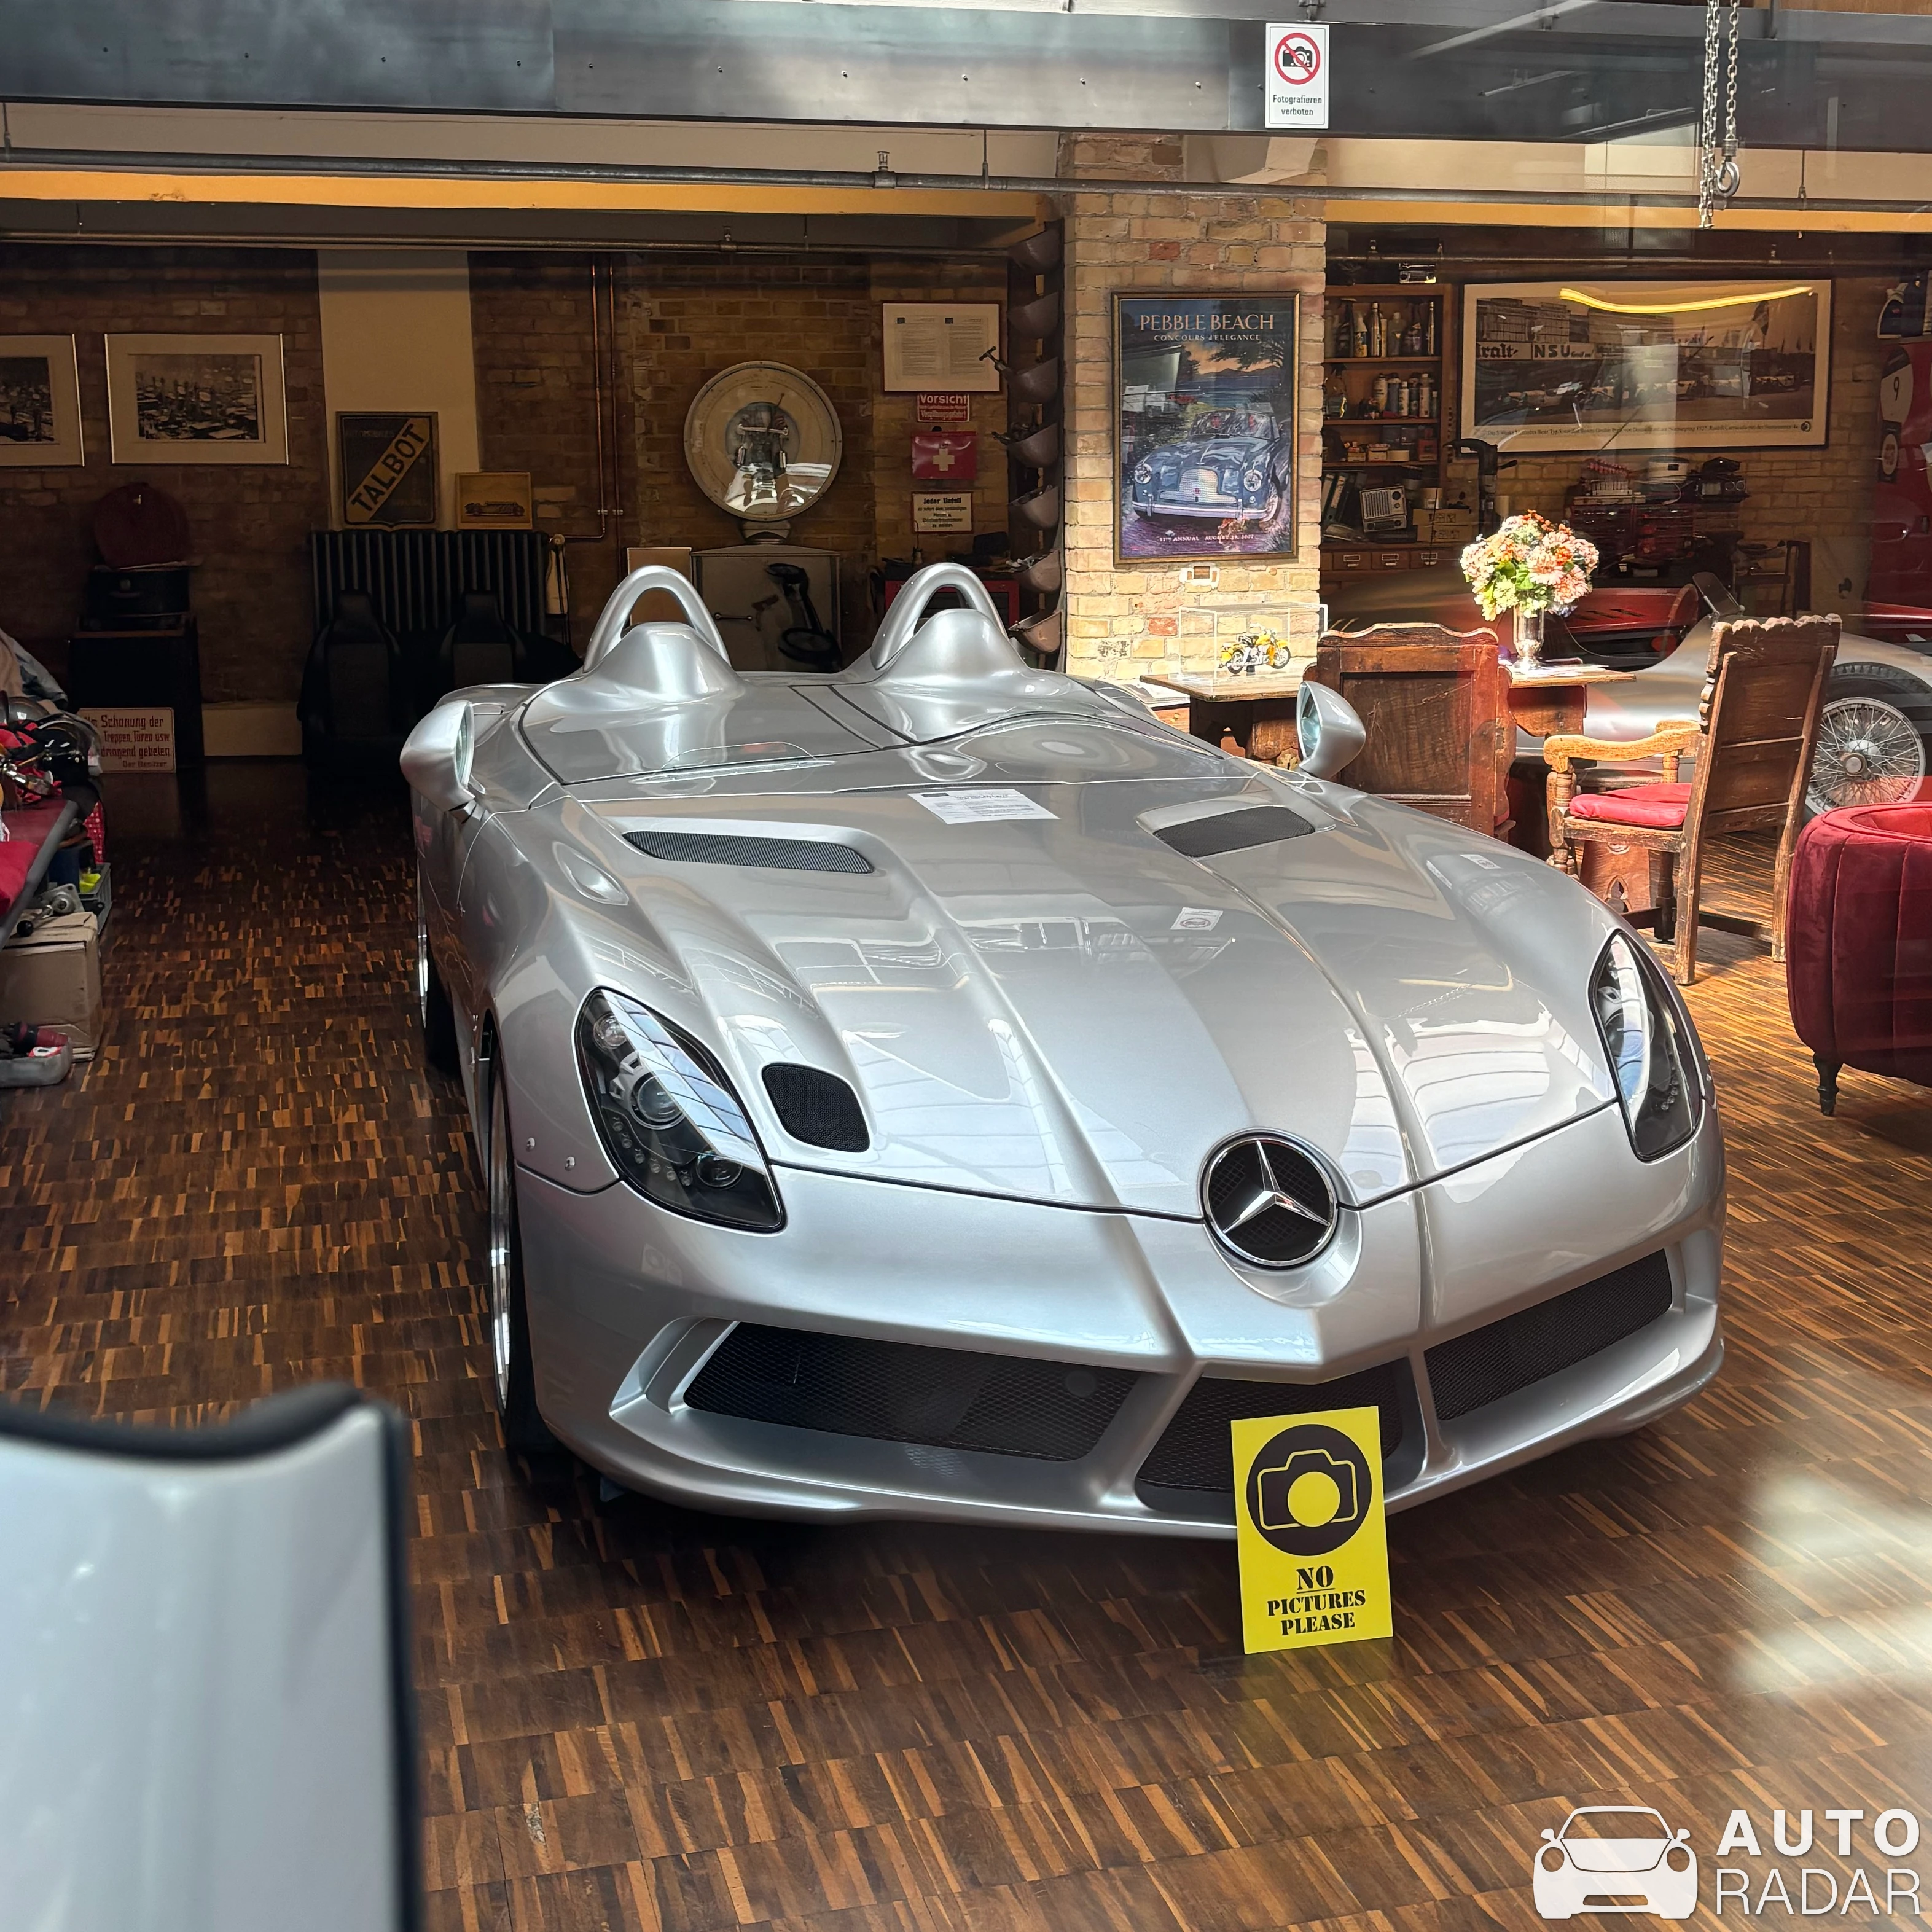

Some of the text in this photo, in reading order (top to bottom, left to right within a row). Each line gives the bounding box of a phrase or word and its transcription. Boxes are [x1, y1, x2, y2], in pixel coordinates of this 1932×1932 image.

[1273, 95, 1322, 104] Fotografieren
[1281, 107, 1313, 115] verboten
[1140, 314, 1273, 330] PEBBLE BEACH
[920, 394, 967, 404] Vorsicht
[351, 423, 425, 512] TALBOT
[101, 714, 146, 730] Schonung
[149, 716, 164, 727] der
[101, 745, 136, 759] dringend
[1296, 1565, 1334, 1590] NO
[1267, 1589, 1366, 1617] PICTURES
[1281, 1613, 1356, 1636] PLEASE
